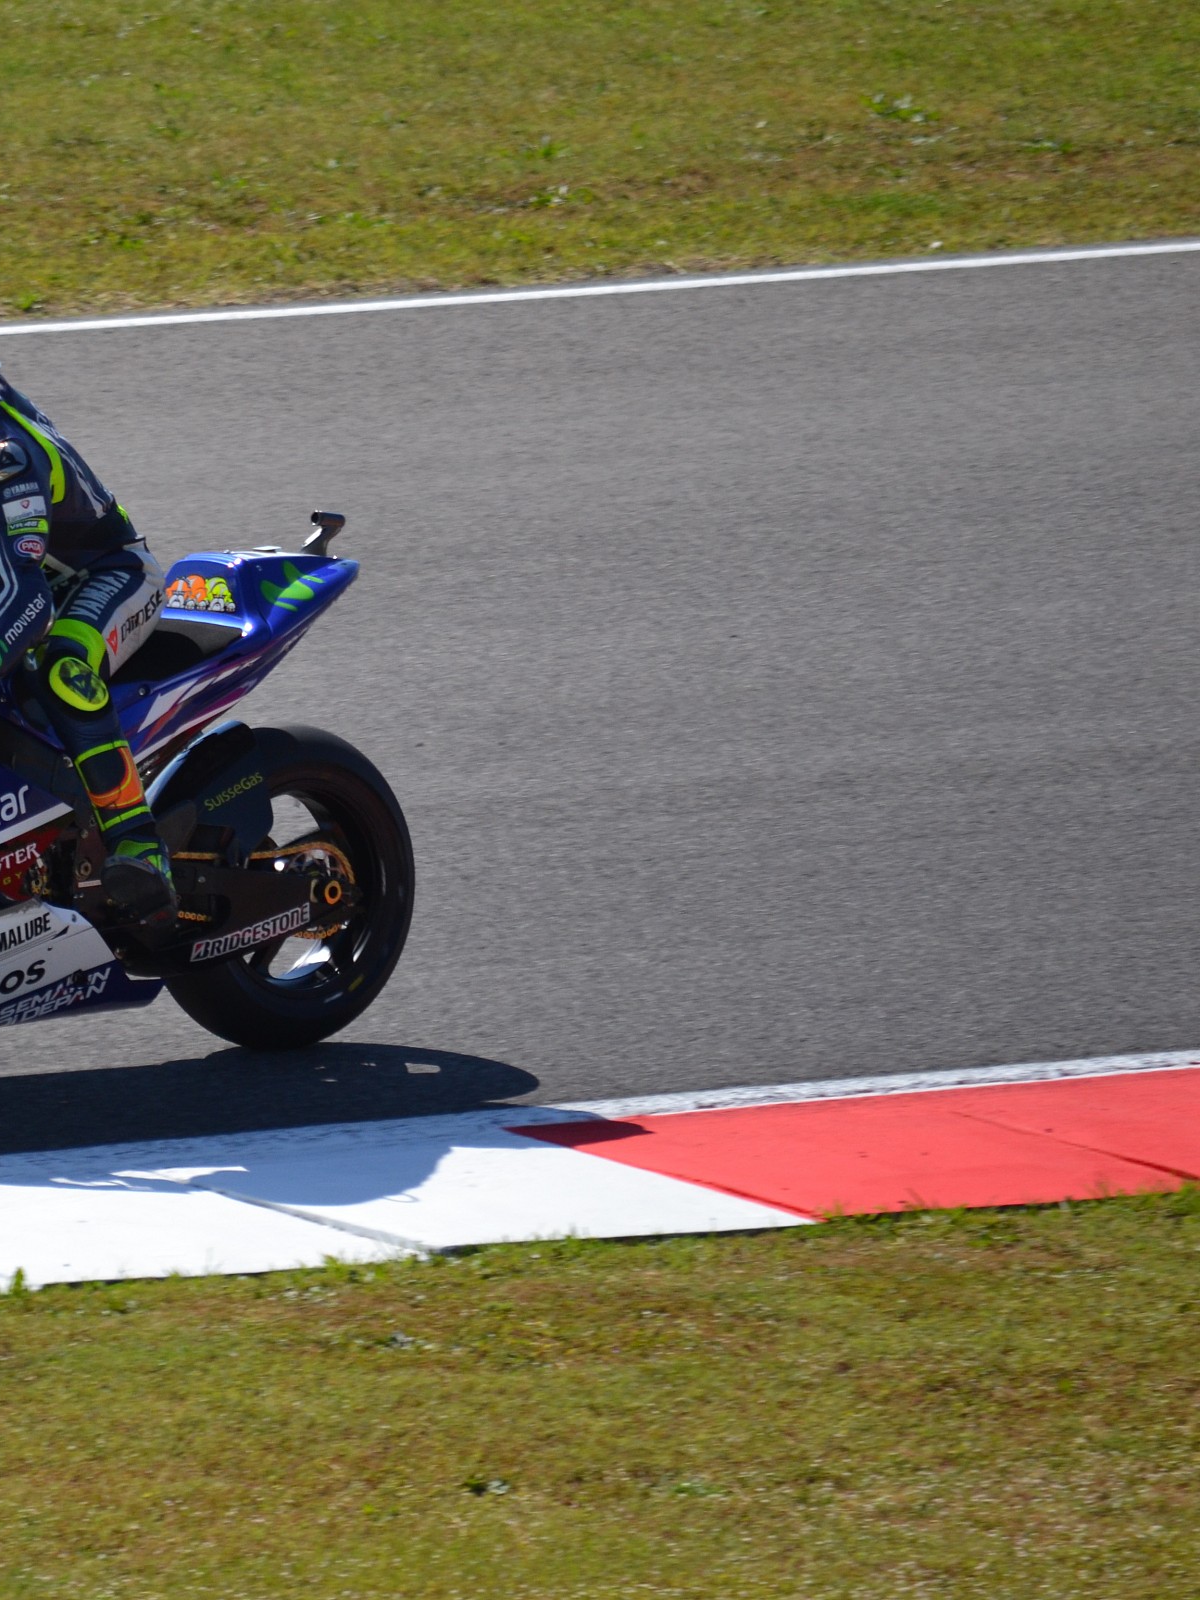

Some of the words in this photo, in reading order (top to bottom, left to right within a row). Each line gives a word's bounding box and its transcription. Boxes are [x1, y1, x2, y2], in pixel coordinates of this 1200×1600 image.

[11, 482, 39, 493] YAMAHA
[4, 593, 46, 645] movistar
[67, 570, 131, 621] YAMAHA
[190, 902, 311, 963] BRIDGESTONE
